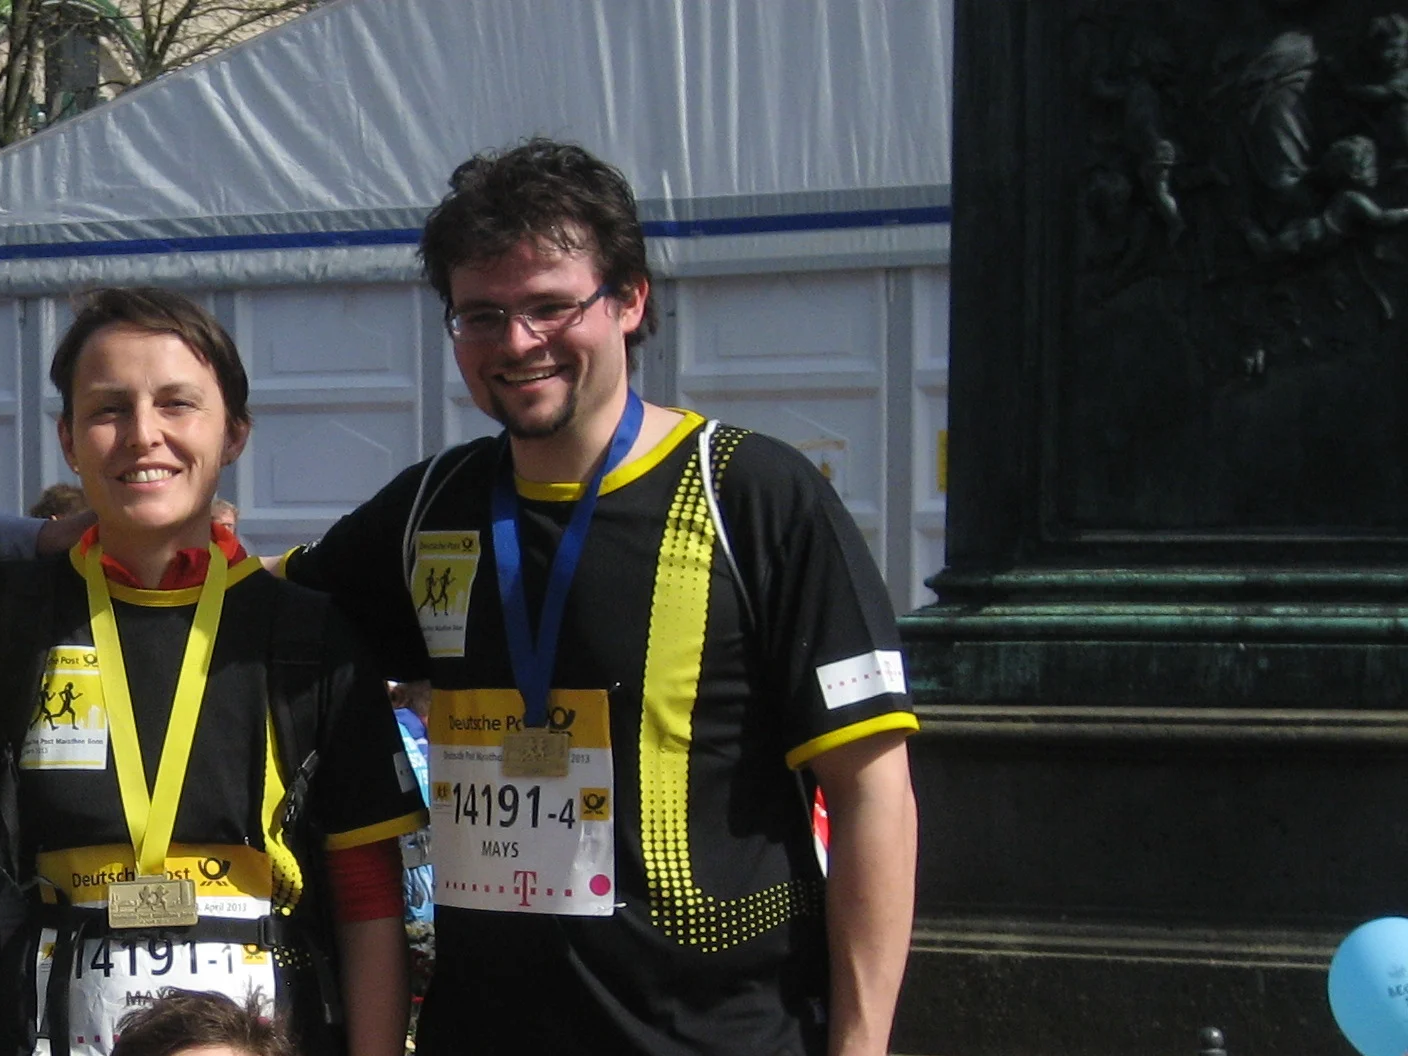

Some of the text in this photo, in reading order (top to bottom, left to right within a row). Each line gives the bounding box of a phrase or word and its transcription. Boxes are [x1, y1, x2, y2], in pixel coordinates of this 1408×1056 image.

[60, 656, 80, 665] Post
[448, 714, 522, 732] Deutsche Po
[570, 754, 590, 764] 2013
[453, 782, 576, 830] 14191-4
[482, 840, 519, 858] MAYS
[72, 867, 192, 888] Deutsch ost
[204, 902, 224, 912] April
[226, 903, 248, 912] 2013
[74, 938, 234, 979] 14191-1
